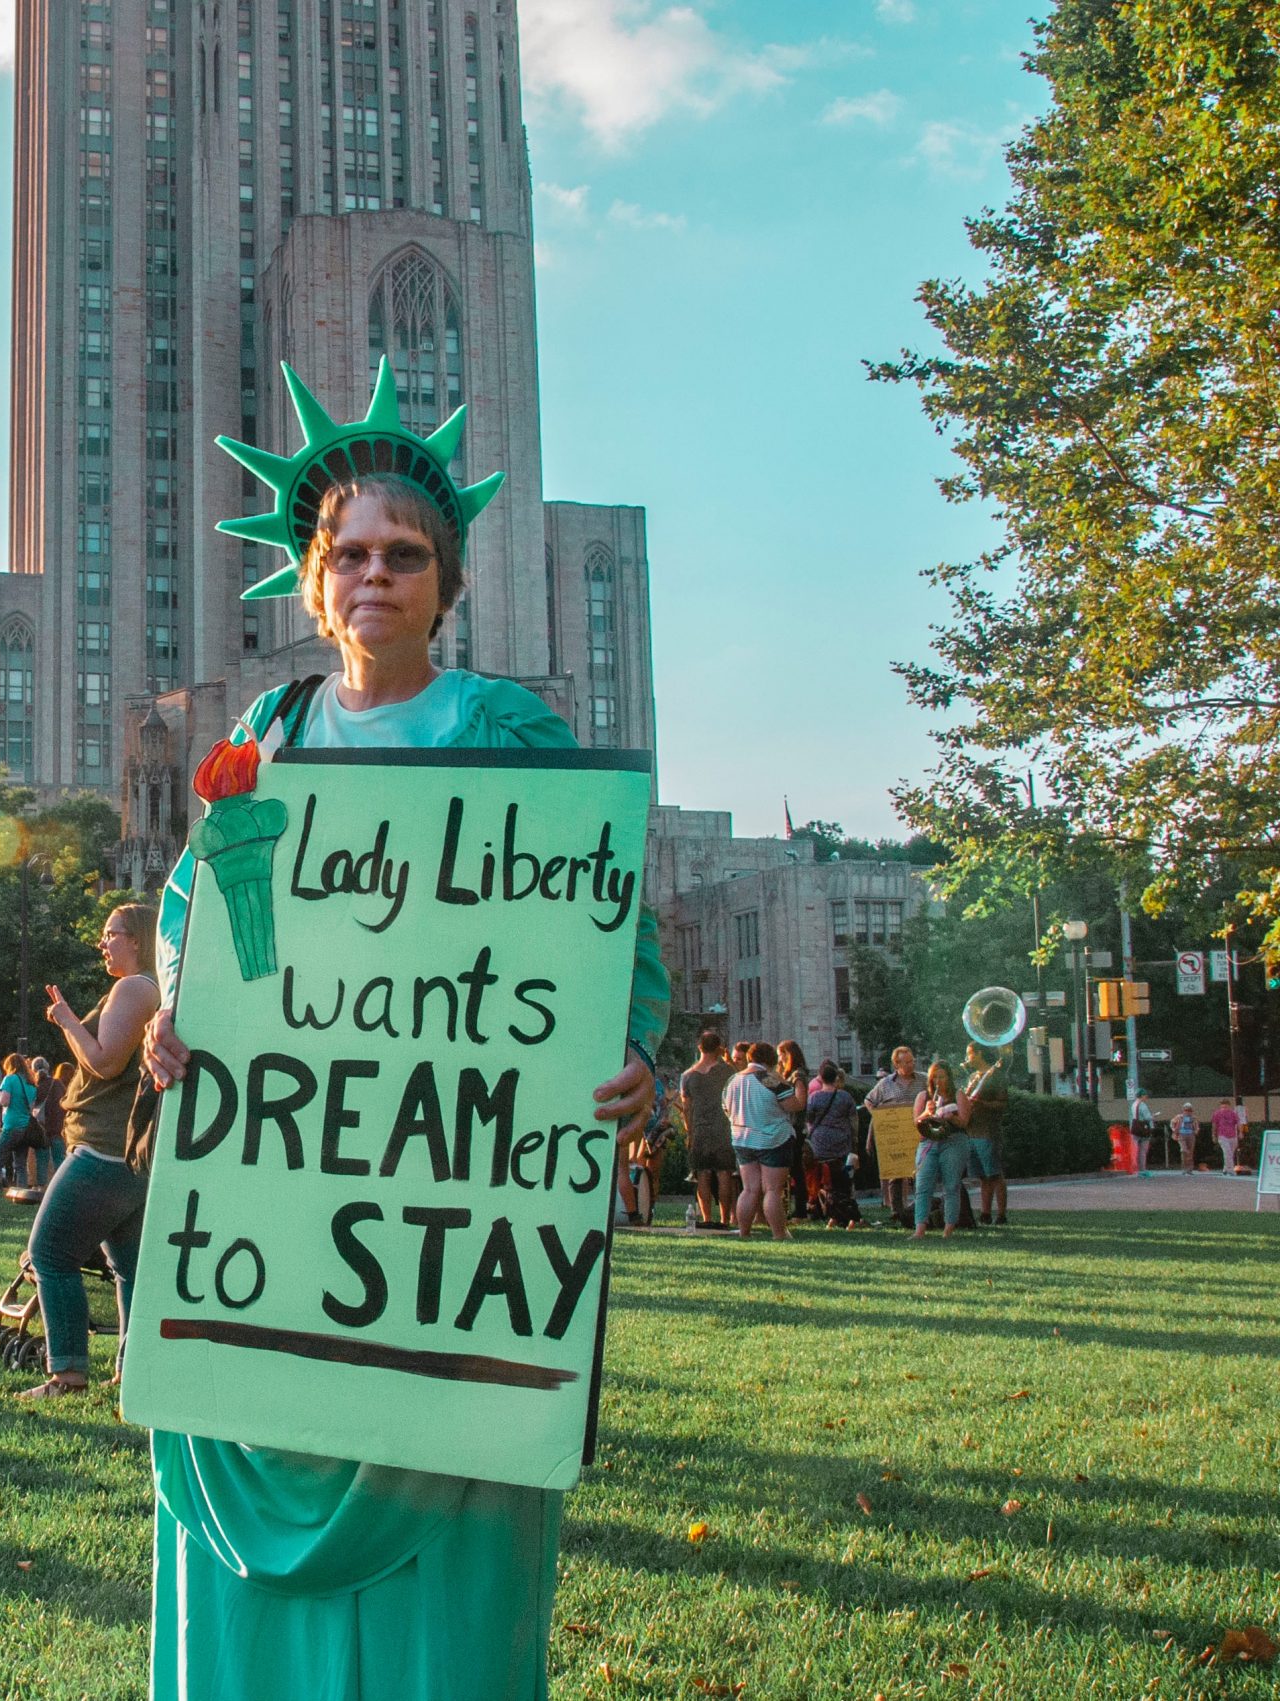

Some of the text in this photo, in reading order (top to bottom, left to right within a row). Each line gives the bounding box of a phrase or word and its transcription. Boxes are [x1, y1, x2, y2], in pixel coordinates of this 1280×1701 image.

[290, 794, 636, 932] Lady Liberty
[282, 946, 557, 1045] wants
[175, 1050, 608, 1192] DREAMers
[167, 1190, 606, 1339] to STAY
